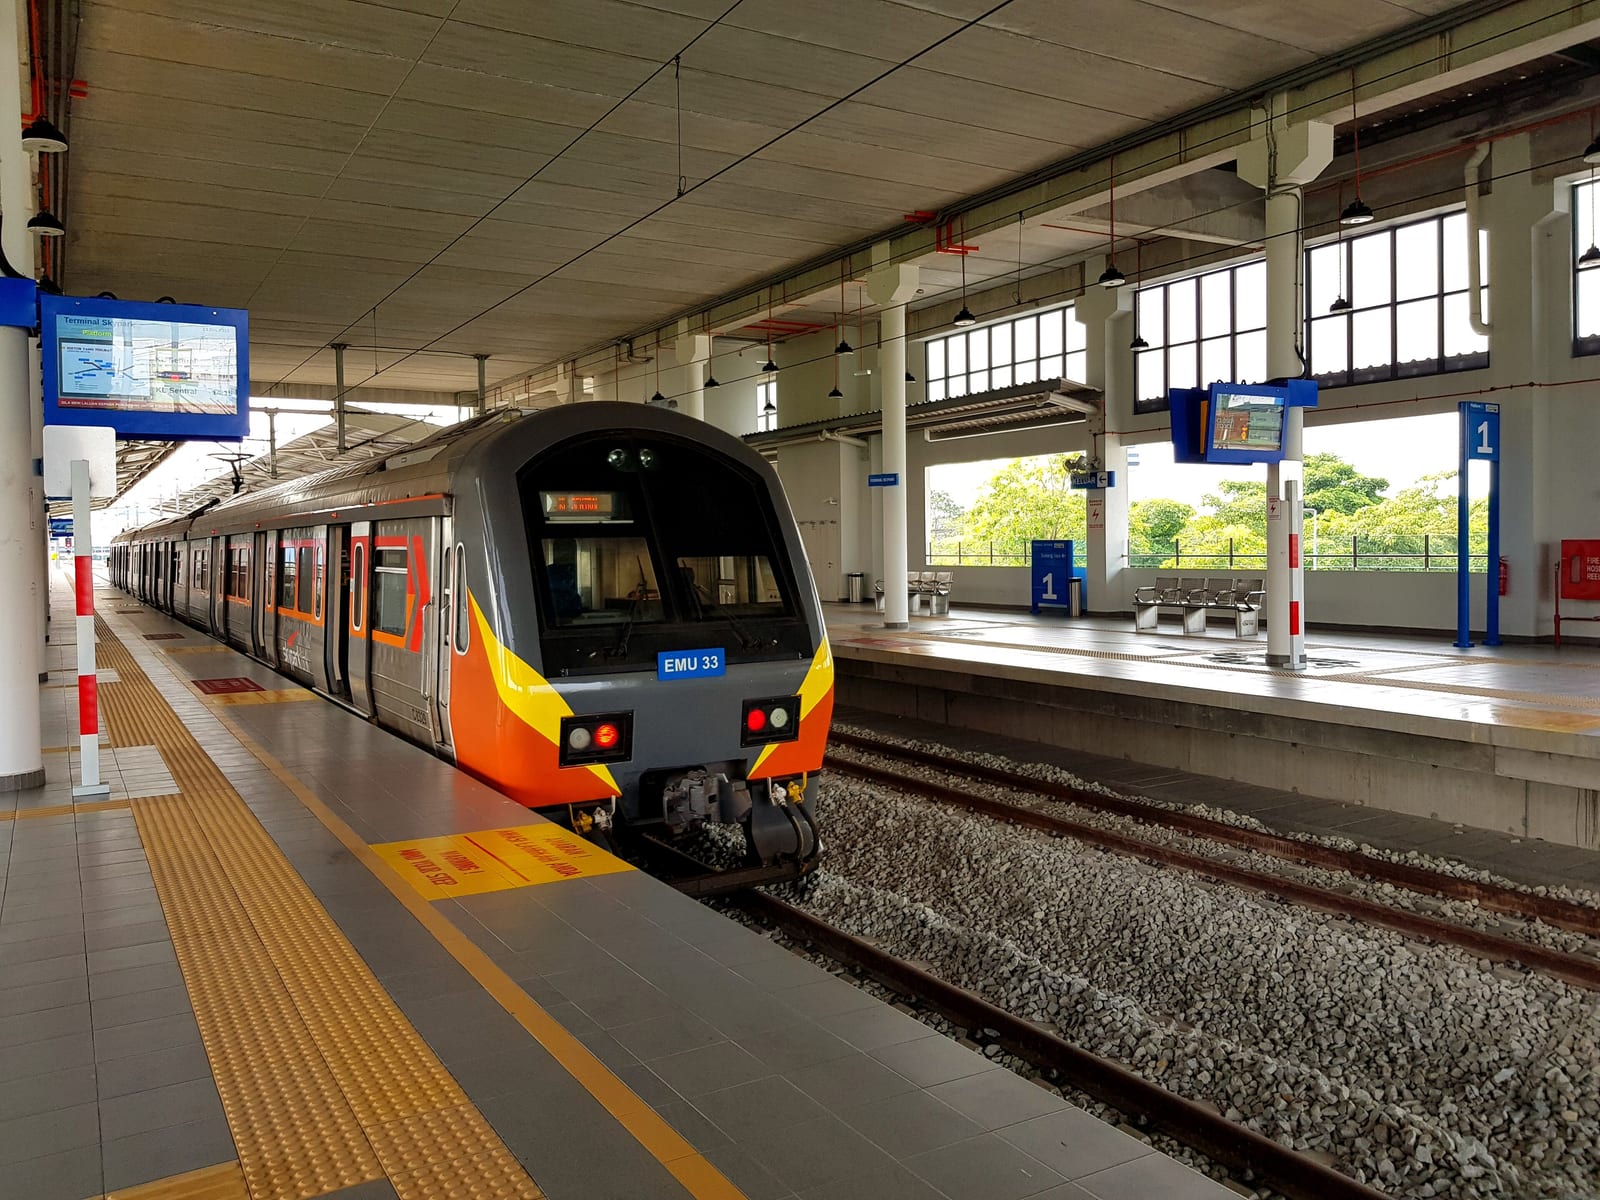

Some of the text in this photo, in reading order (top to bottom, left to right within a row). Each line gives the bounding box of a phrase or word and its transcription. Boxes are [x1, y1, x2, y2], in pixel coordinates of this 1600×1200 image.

[64, 316, 99, 326] Terminal
[82, 329, 112, 337] Platform
[169, 387, 197, 395] Sentral
[1477, 421, 1493, 453] 1
[1042, 572, 1057, 600] 1
[664, 656, 718, 672] EMU 33
[412, 860, 442, 874] YOUR
[426, 872, 458, 885] STEP
